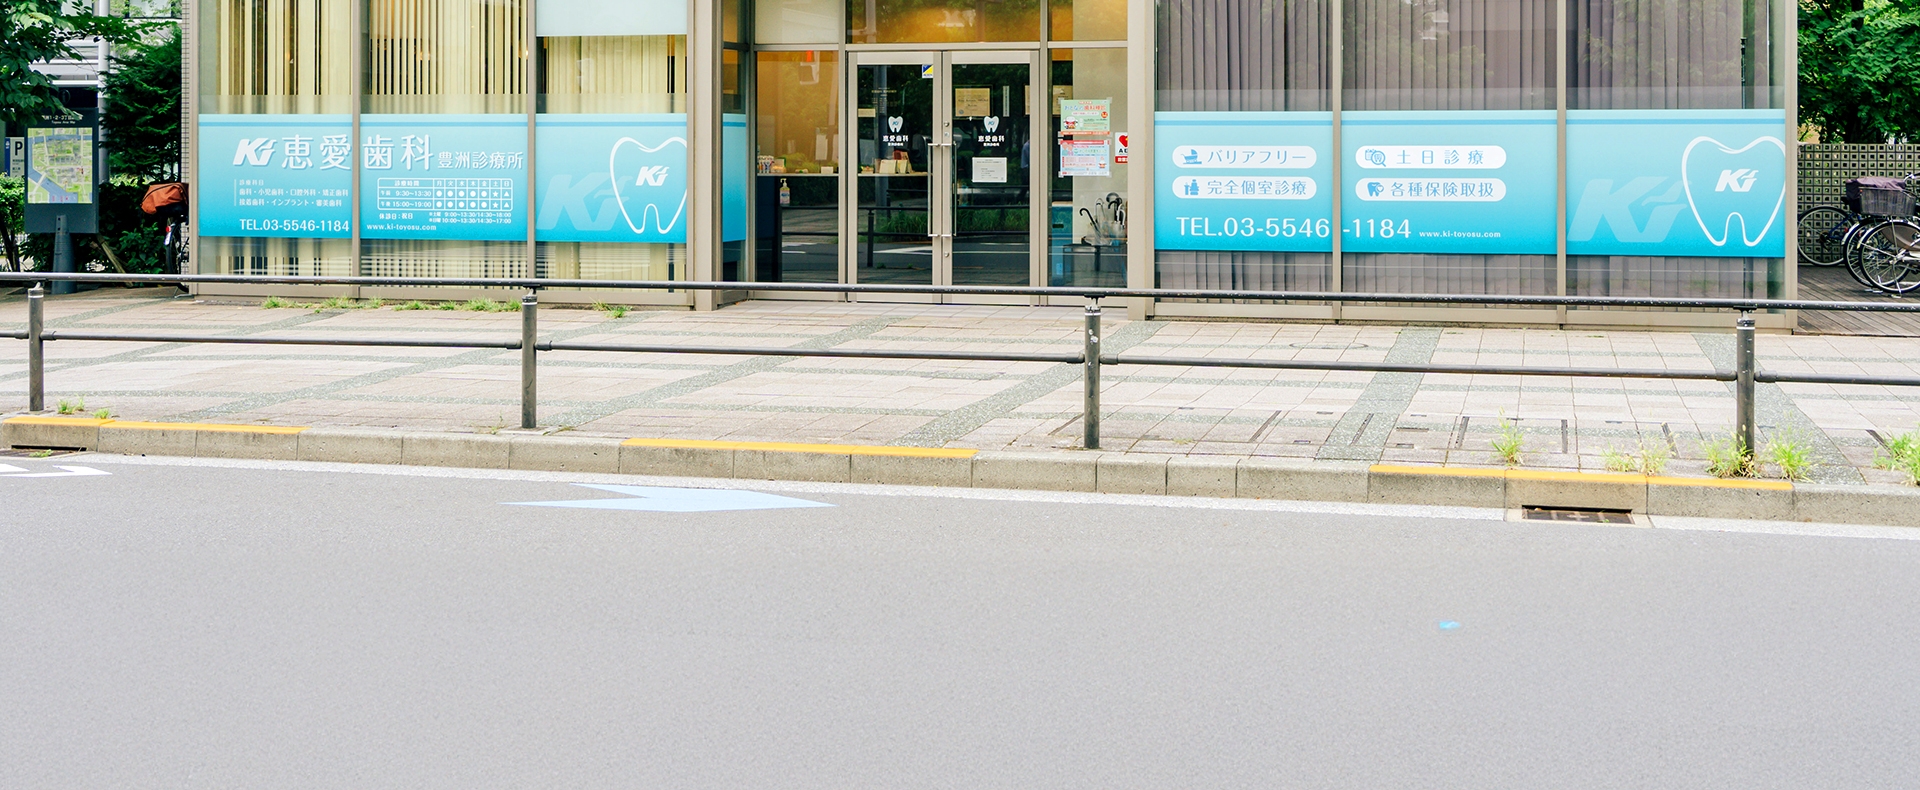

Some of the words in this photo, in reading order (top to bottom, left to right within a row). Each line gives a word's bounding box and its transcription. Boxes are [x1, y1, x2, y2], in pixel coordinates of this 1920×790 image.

[15, 141, 23, 156] P
[437, 151, 524, 170] 豊洲診療所
[1207, 149, 1307, 165] バリアフリー
[1396, 149, 1484, 165] 土日診療
[1207, 180, 1307, 196] 完全個室診療
[1391, 181, 1494, 198] 各種保険取扱
[239, 218, 350, 232] TEL.03-5546-1184
[1419, 230, 1501, 239] www.ki-toyosu.com
